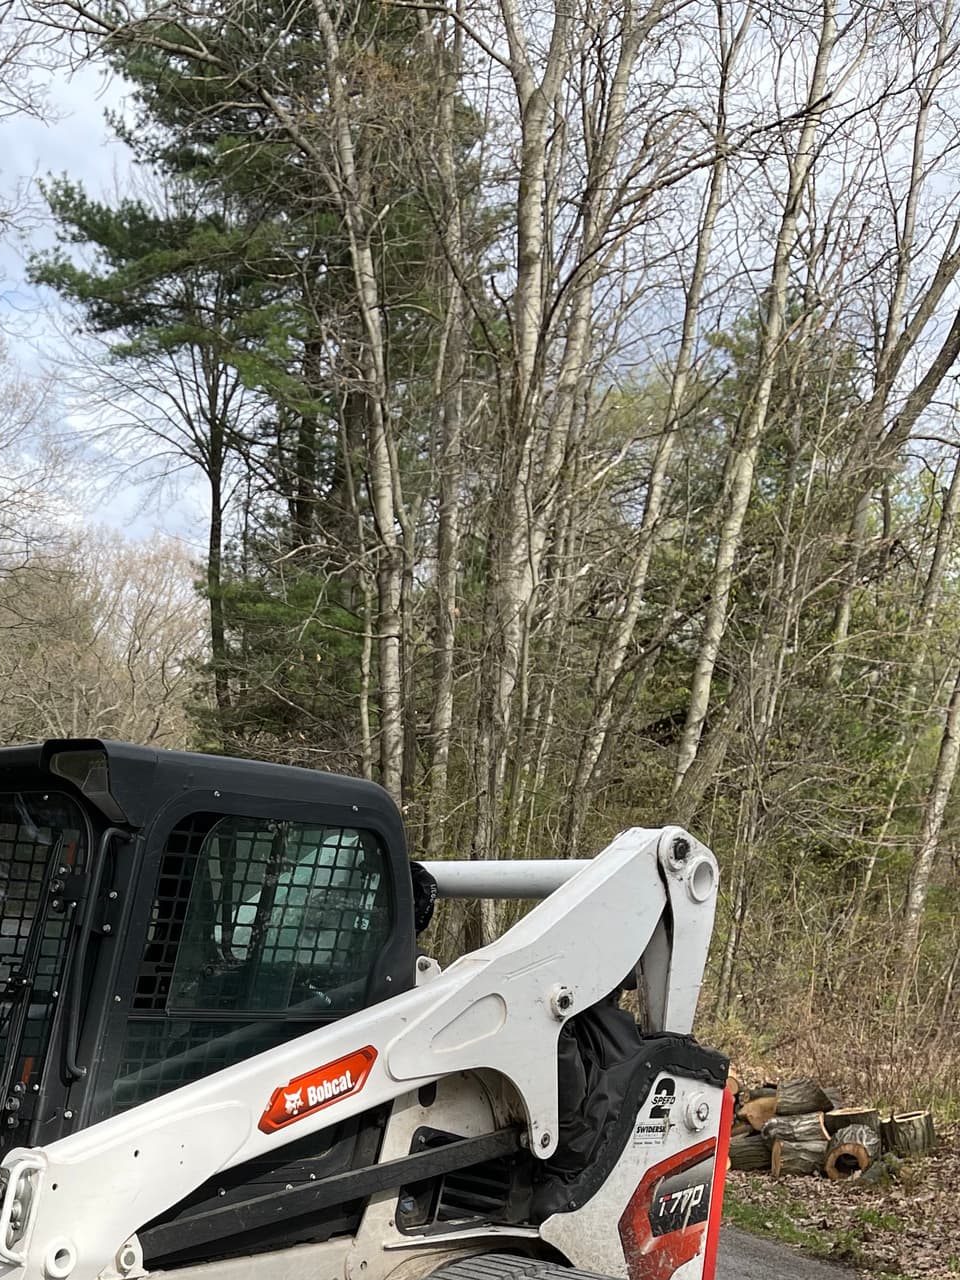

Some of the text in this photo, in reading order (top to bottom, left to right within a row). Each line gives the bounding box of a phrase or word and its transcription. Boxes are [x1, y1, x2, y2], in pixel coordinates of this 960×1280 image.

[307, 1070, 353, 1106] Bobcat
[649, 1078, 676, 1119] 2
[651, 1096, 676, 1105] SPEED
